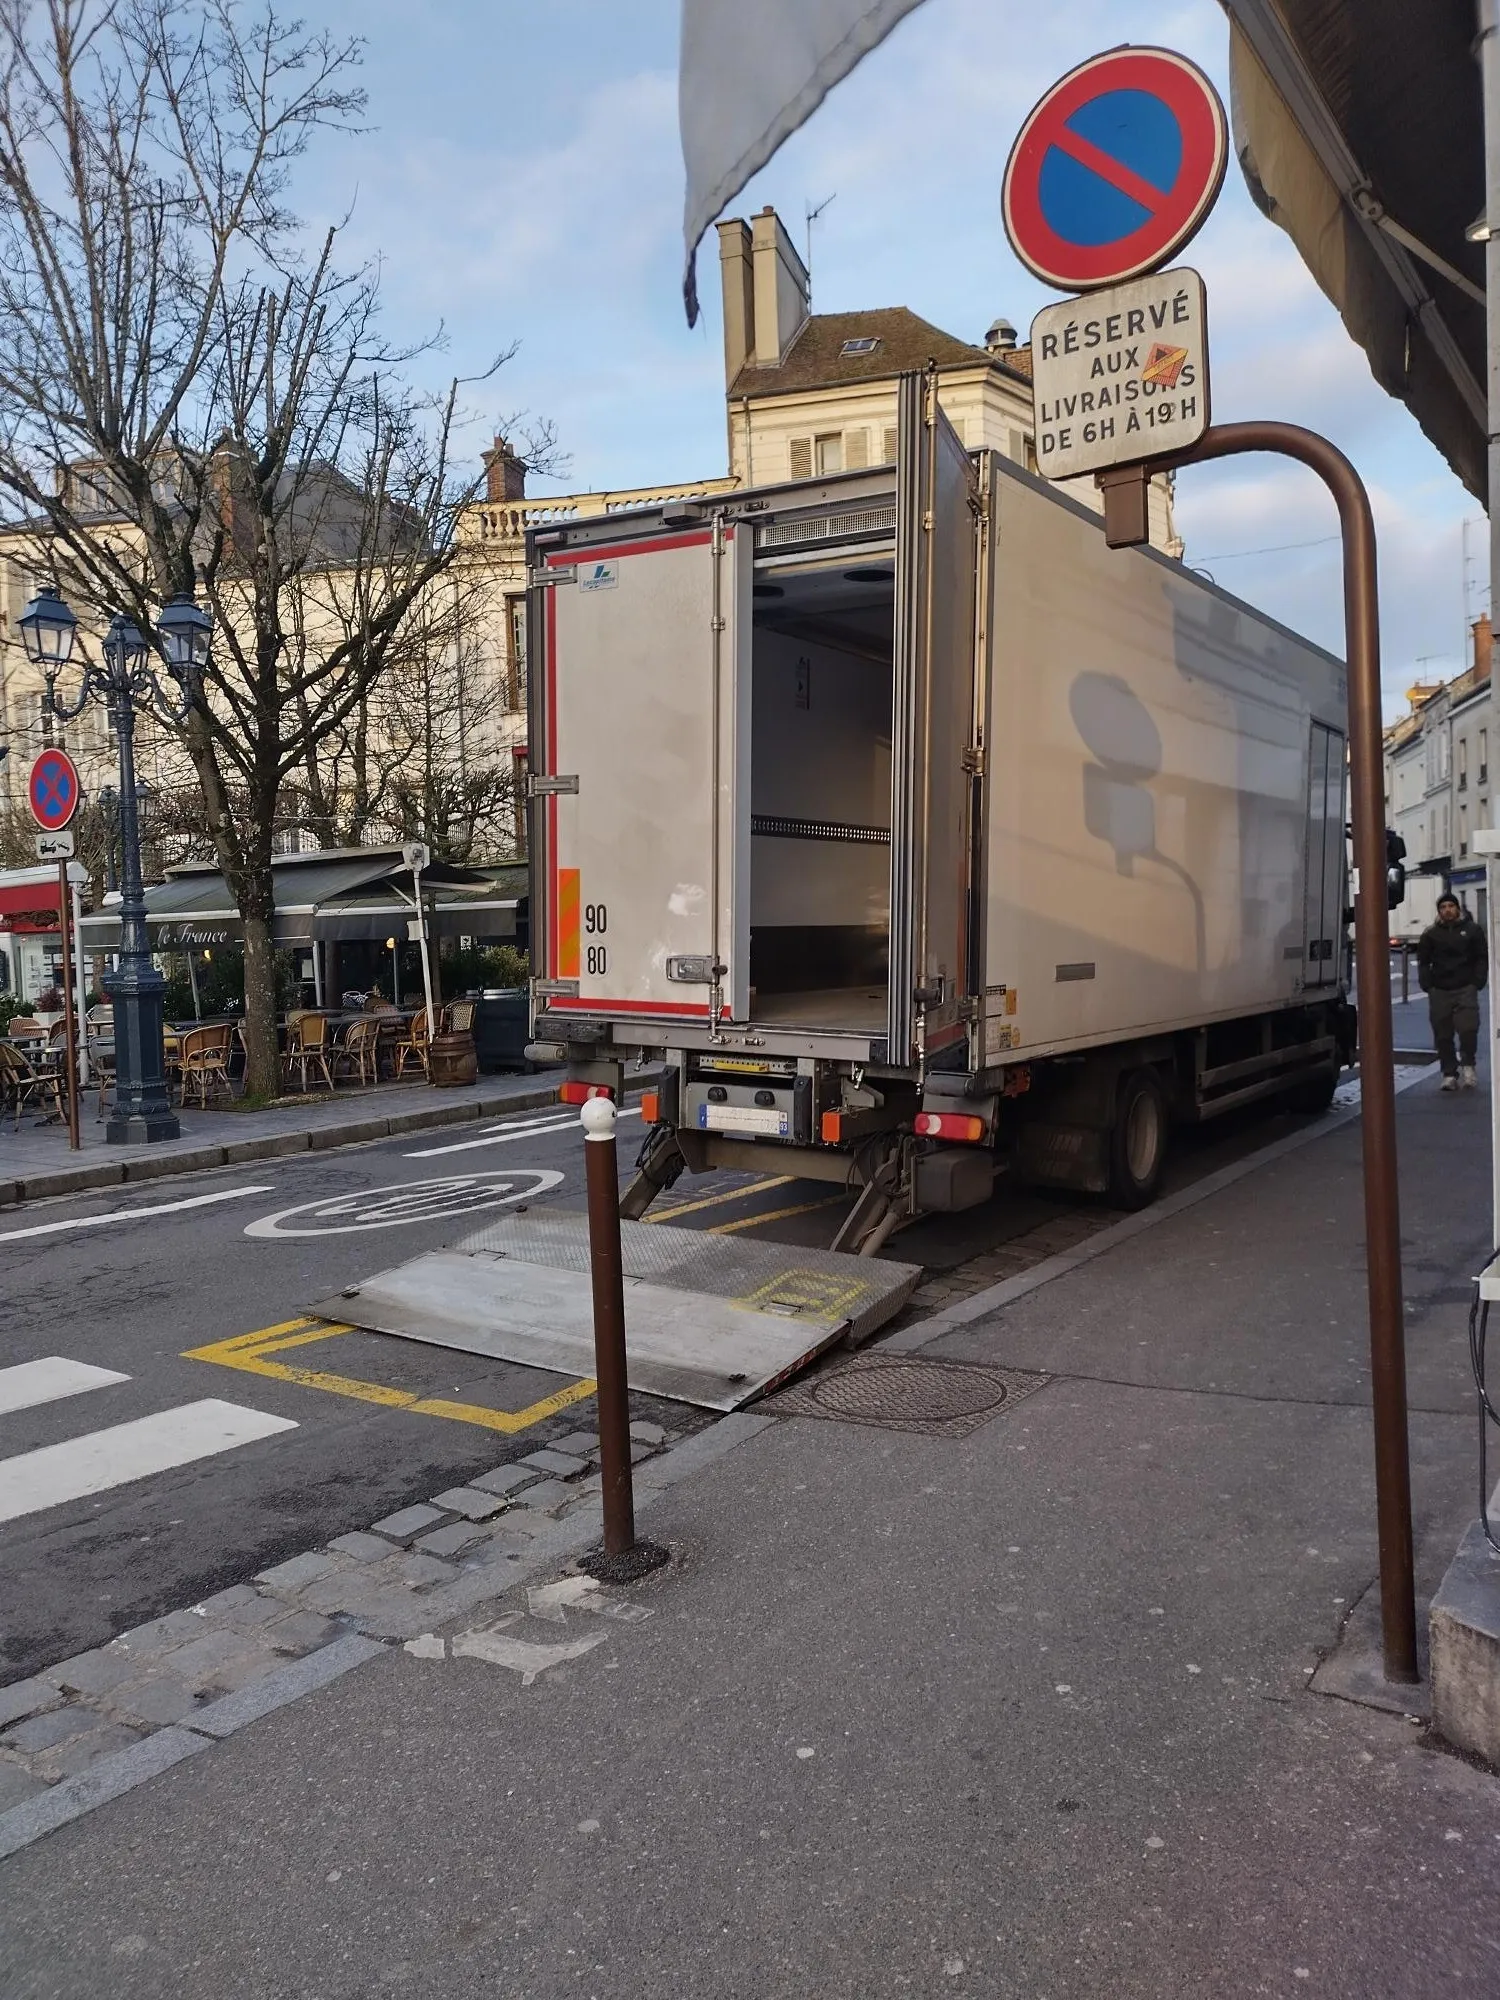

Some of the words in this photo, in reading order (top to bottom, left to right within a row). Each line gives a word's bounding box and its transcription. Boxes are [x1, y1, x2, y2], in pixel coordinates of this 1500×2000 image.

[1041, 290, 1189, 360] RÉSERVÉ
[1090, 346, 1140, 379] AUX
[1041, 365, 1195, 423] LIVRAISOS
[1042, 427, 1073, 455] DE
[1082, 417, 1115, 444] 6H
[1126, 407, 1141, 434] À
[1145, 402, 1173, 428] 19
[1181, 397, 1196, 419] H
[174, 923, 228, 944] France
[585, 904, 607, 934] 90
[588, 946, 606, 975] 80
[779, 1122, 788, 1131] 93
